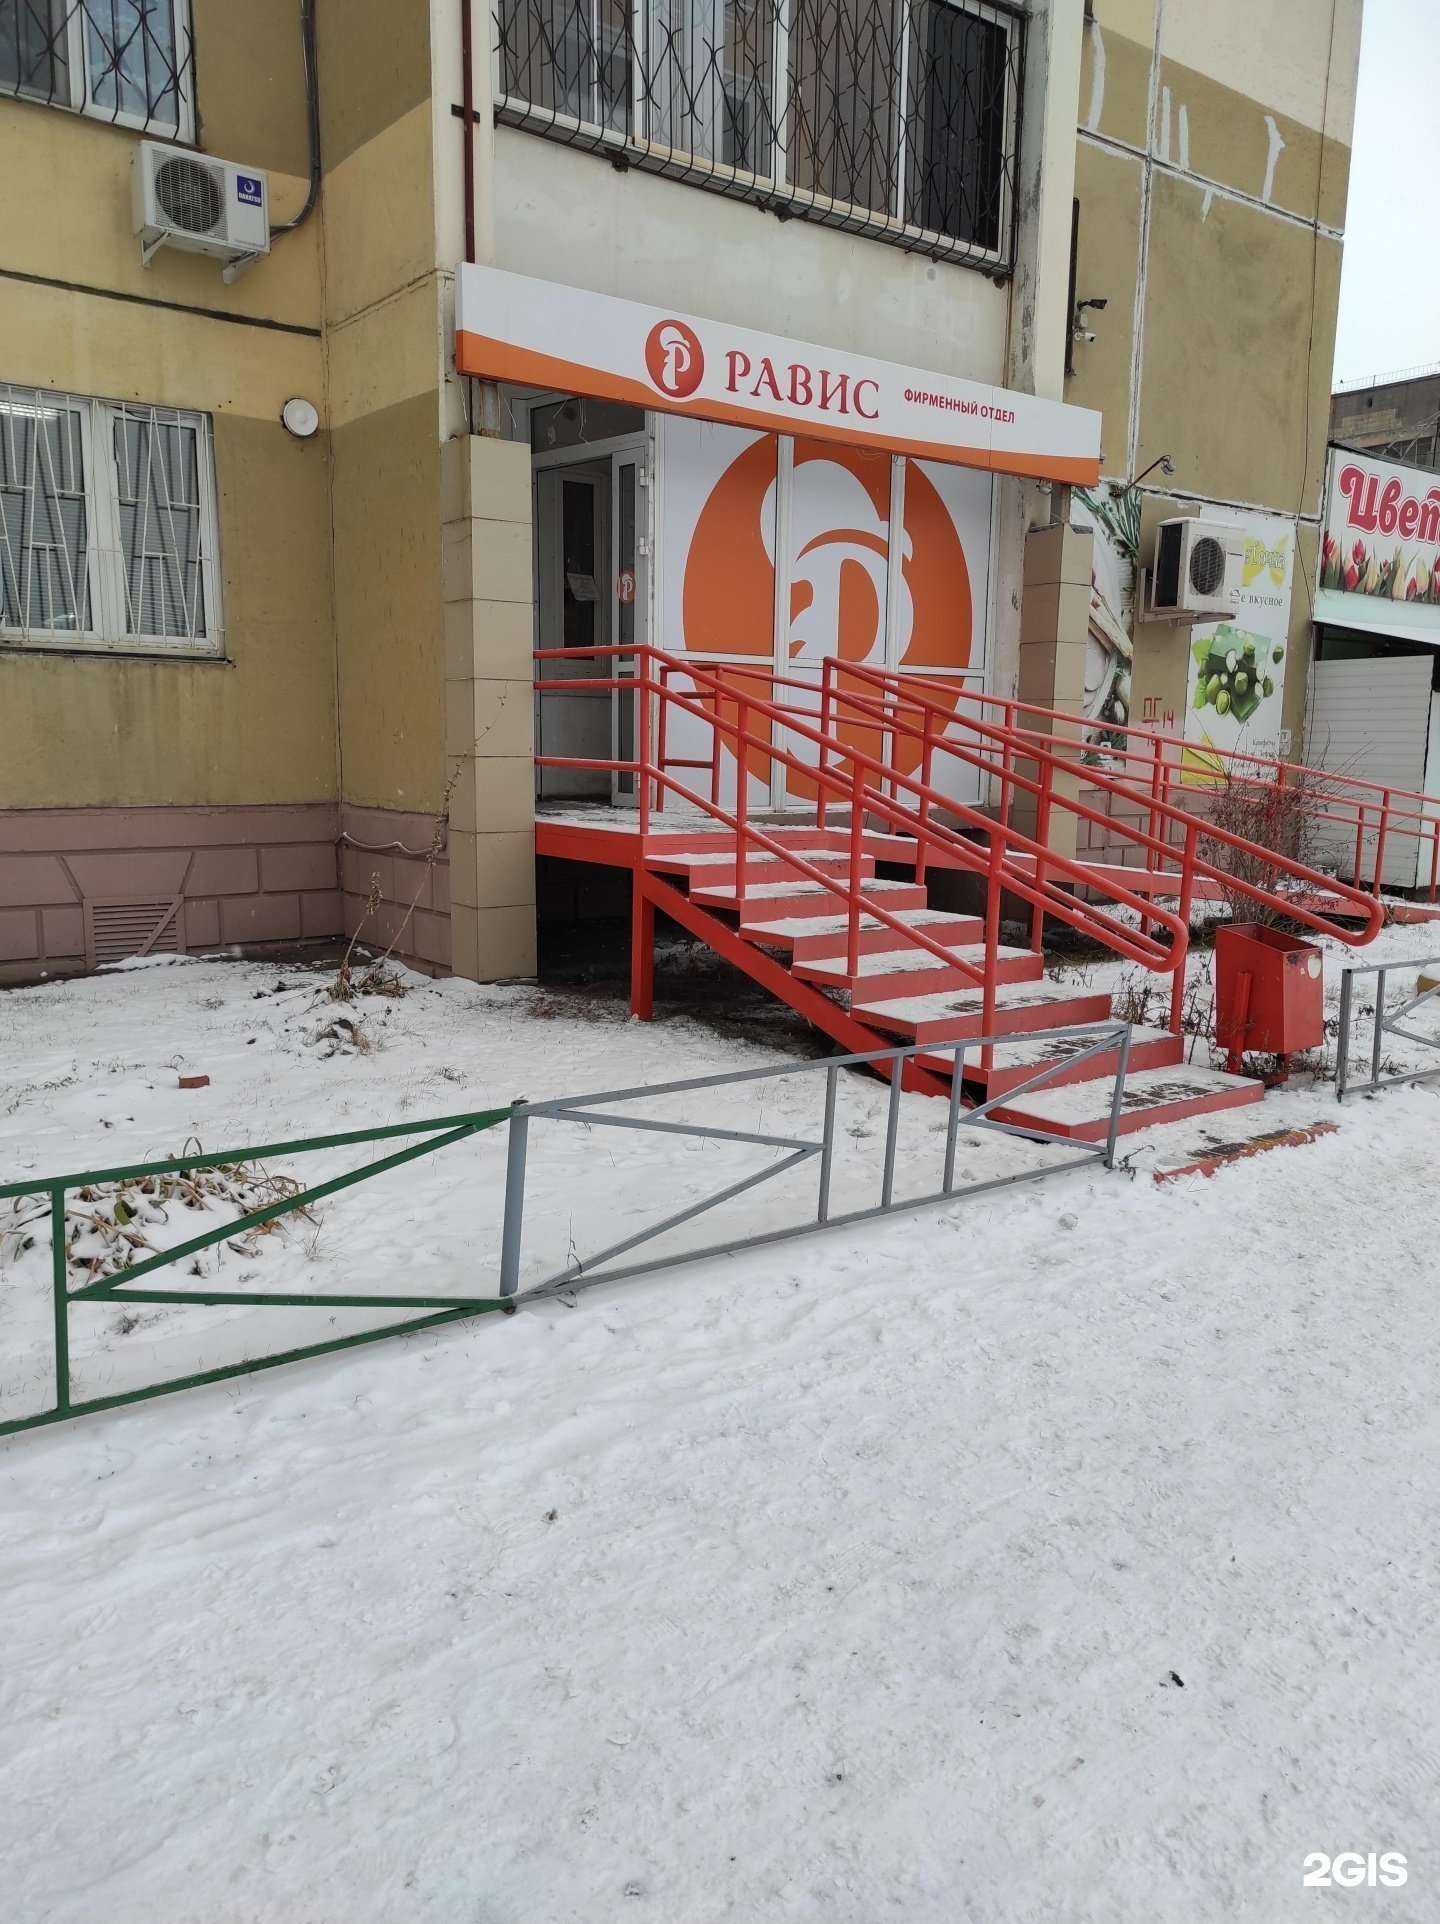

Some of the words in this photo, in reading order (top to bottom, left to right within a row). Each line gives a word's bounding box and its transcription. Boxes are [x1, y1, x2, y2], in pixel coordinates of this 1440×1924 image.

[725, 350, 880, 419] РАВИС
[904, 388, 978, 416] ФИРМЕННЫЙ
[980, 405, 1015, 424] ОТДЕЛ
